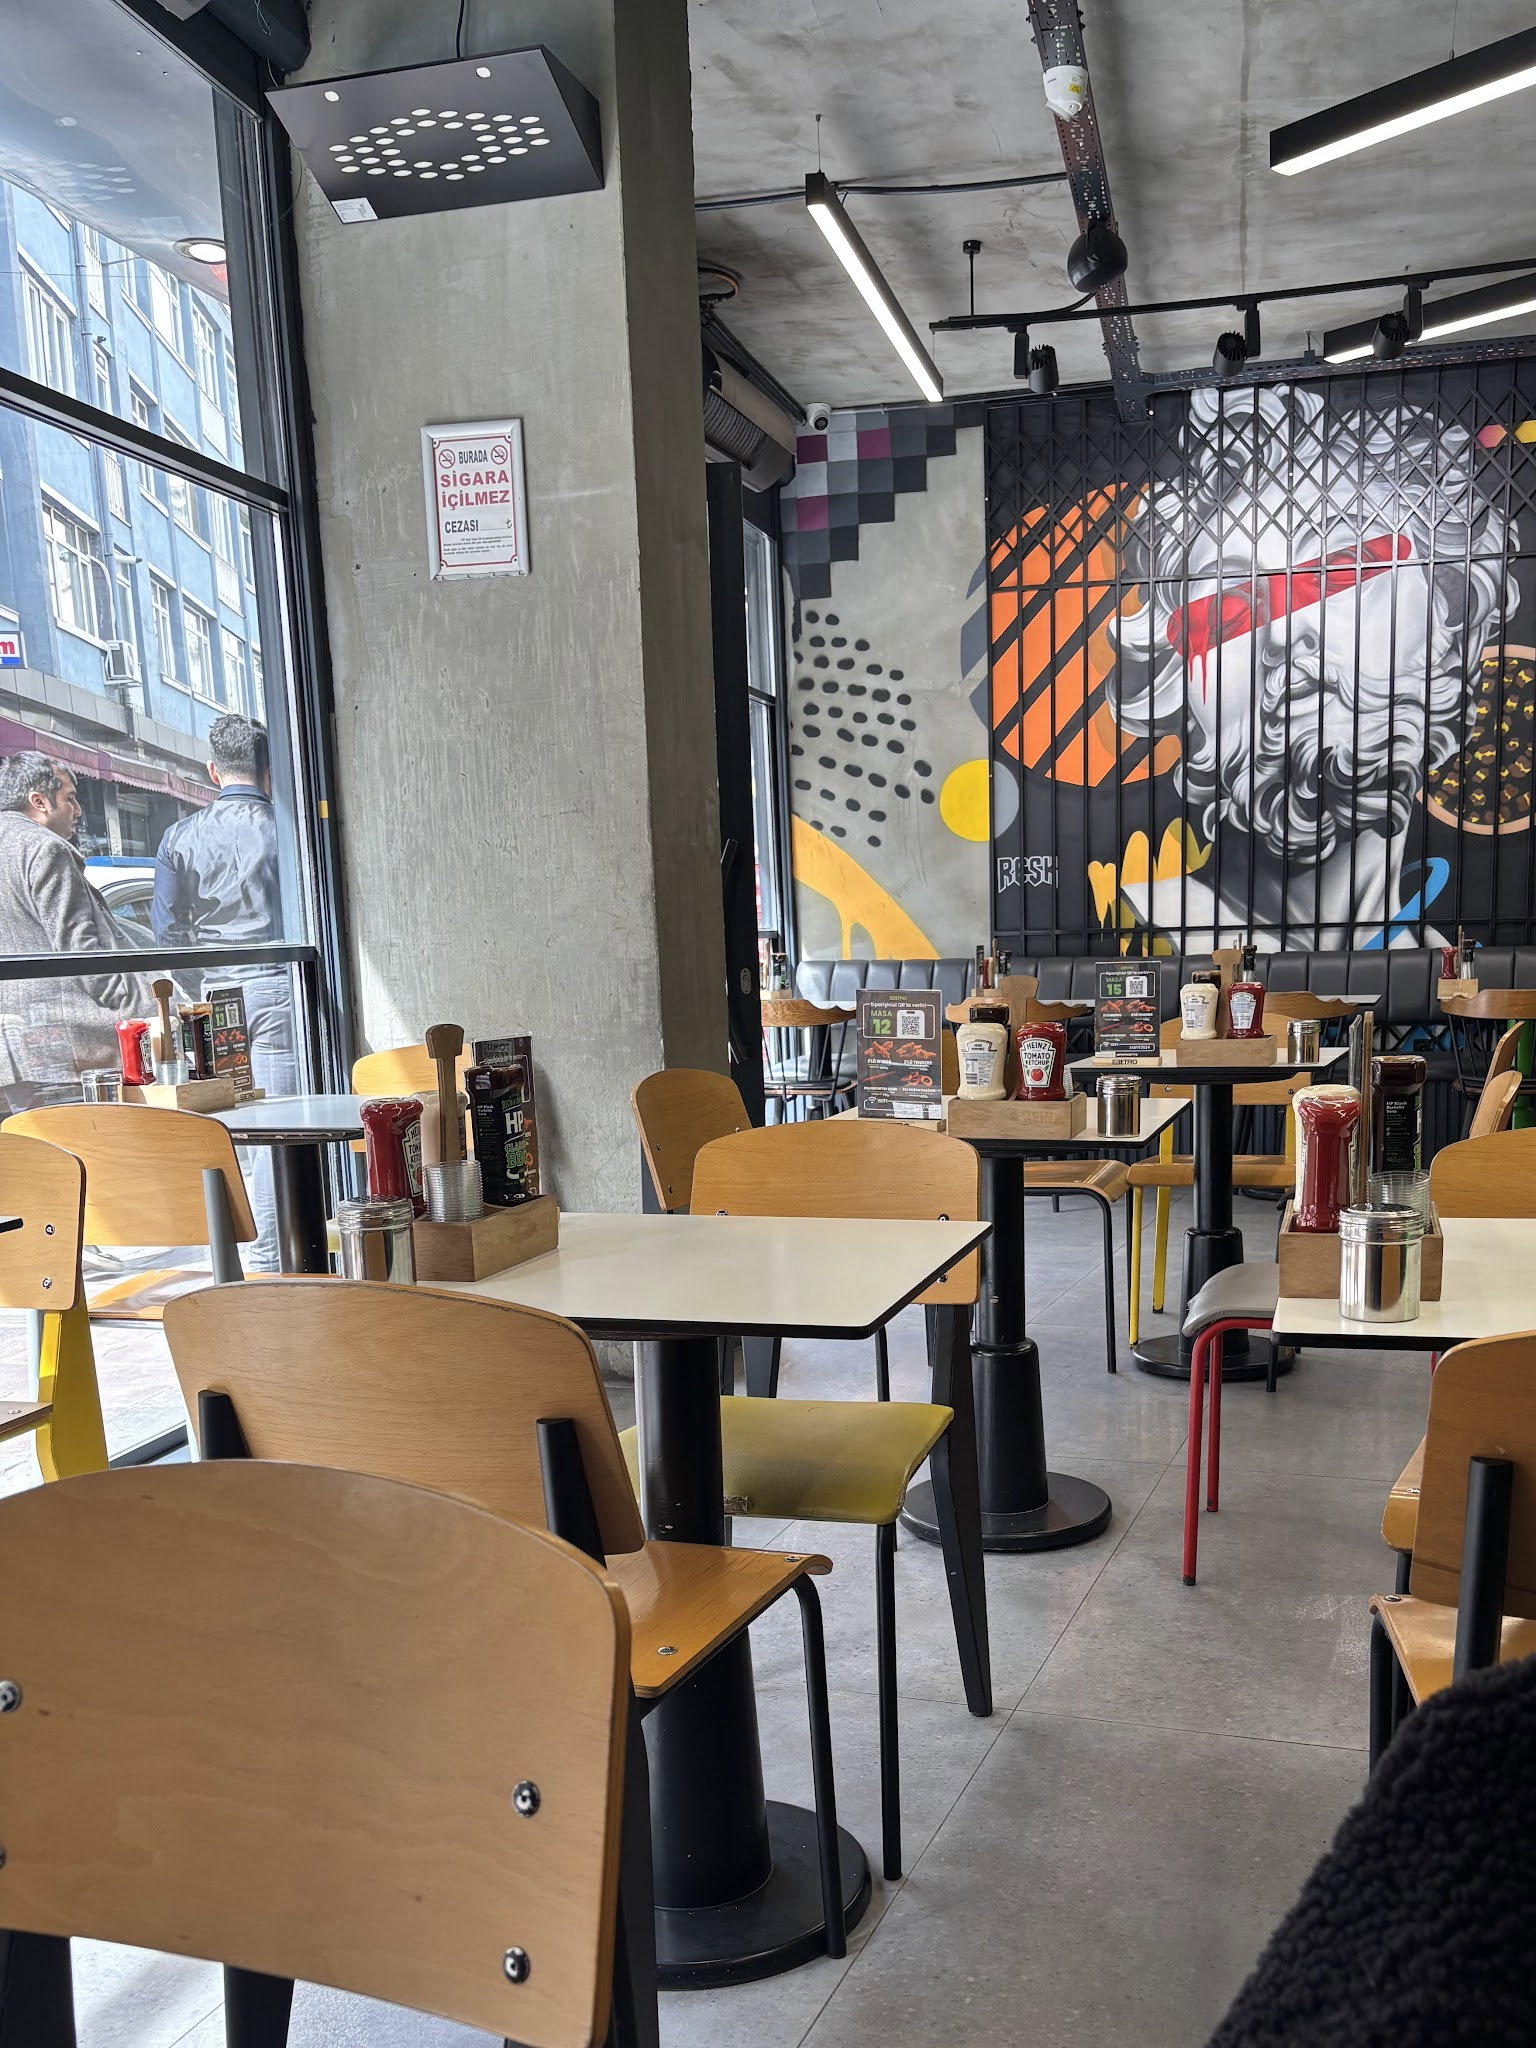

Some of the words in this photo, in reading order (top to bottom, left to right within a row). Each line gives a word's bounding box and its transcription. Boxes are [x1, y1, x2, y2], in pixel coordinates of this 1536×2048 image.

[458, 449, 489, 464] BURADA
[440, 469, 509, 488] SİGARA
[441, 489, 510, 511] İÇİLMEZ
[444, 519, 479, 534] CEZASI
[1106, 983, 1122, 996] 15
[873, 1019, 892, 1035] 12
[1026, 1041, 1048, 1050] HEINZ
[1024, 1052, 1051, 1060] TOMATO
[505, 1110, 524, 1135] HP
